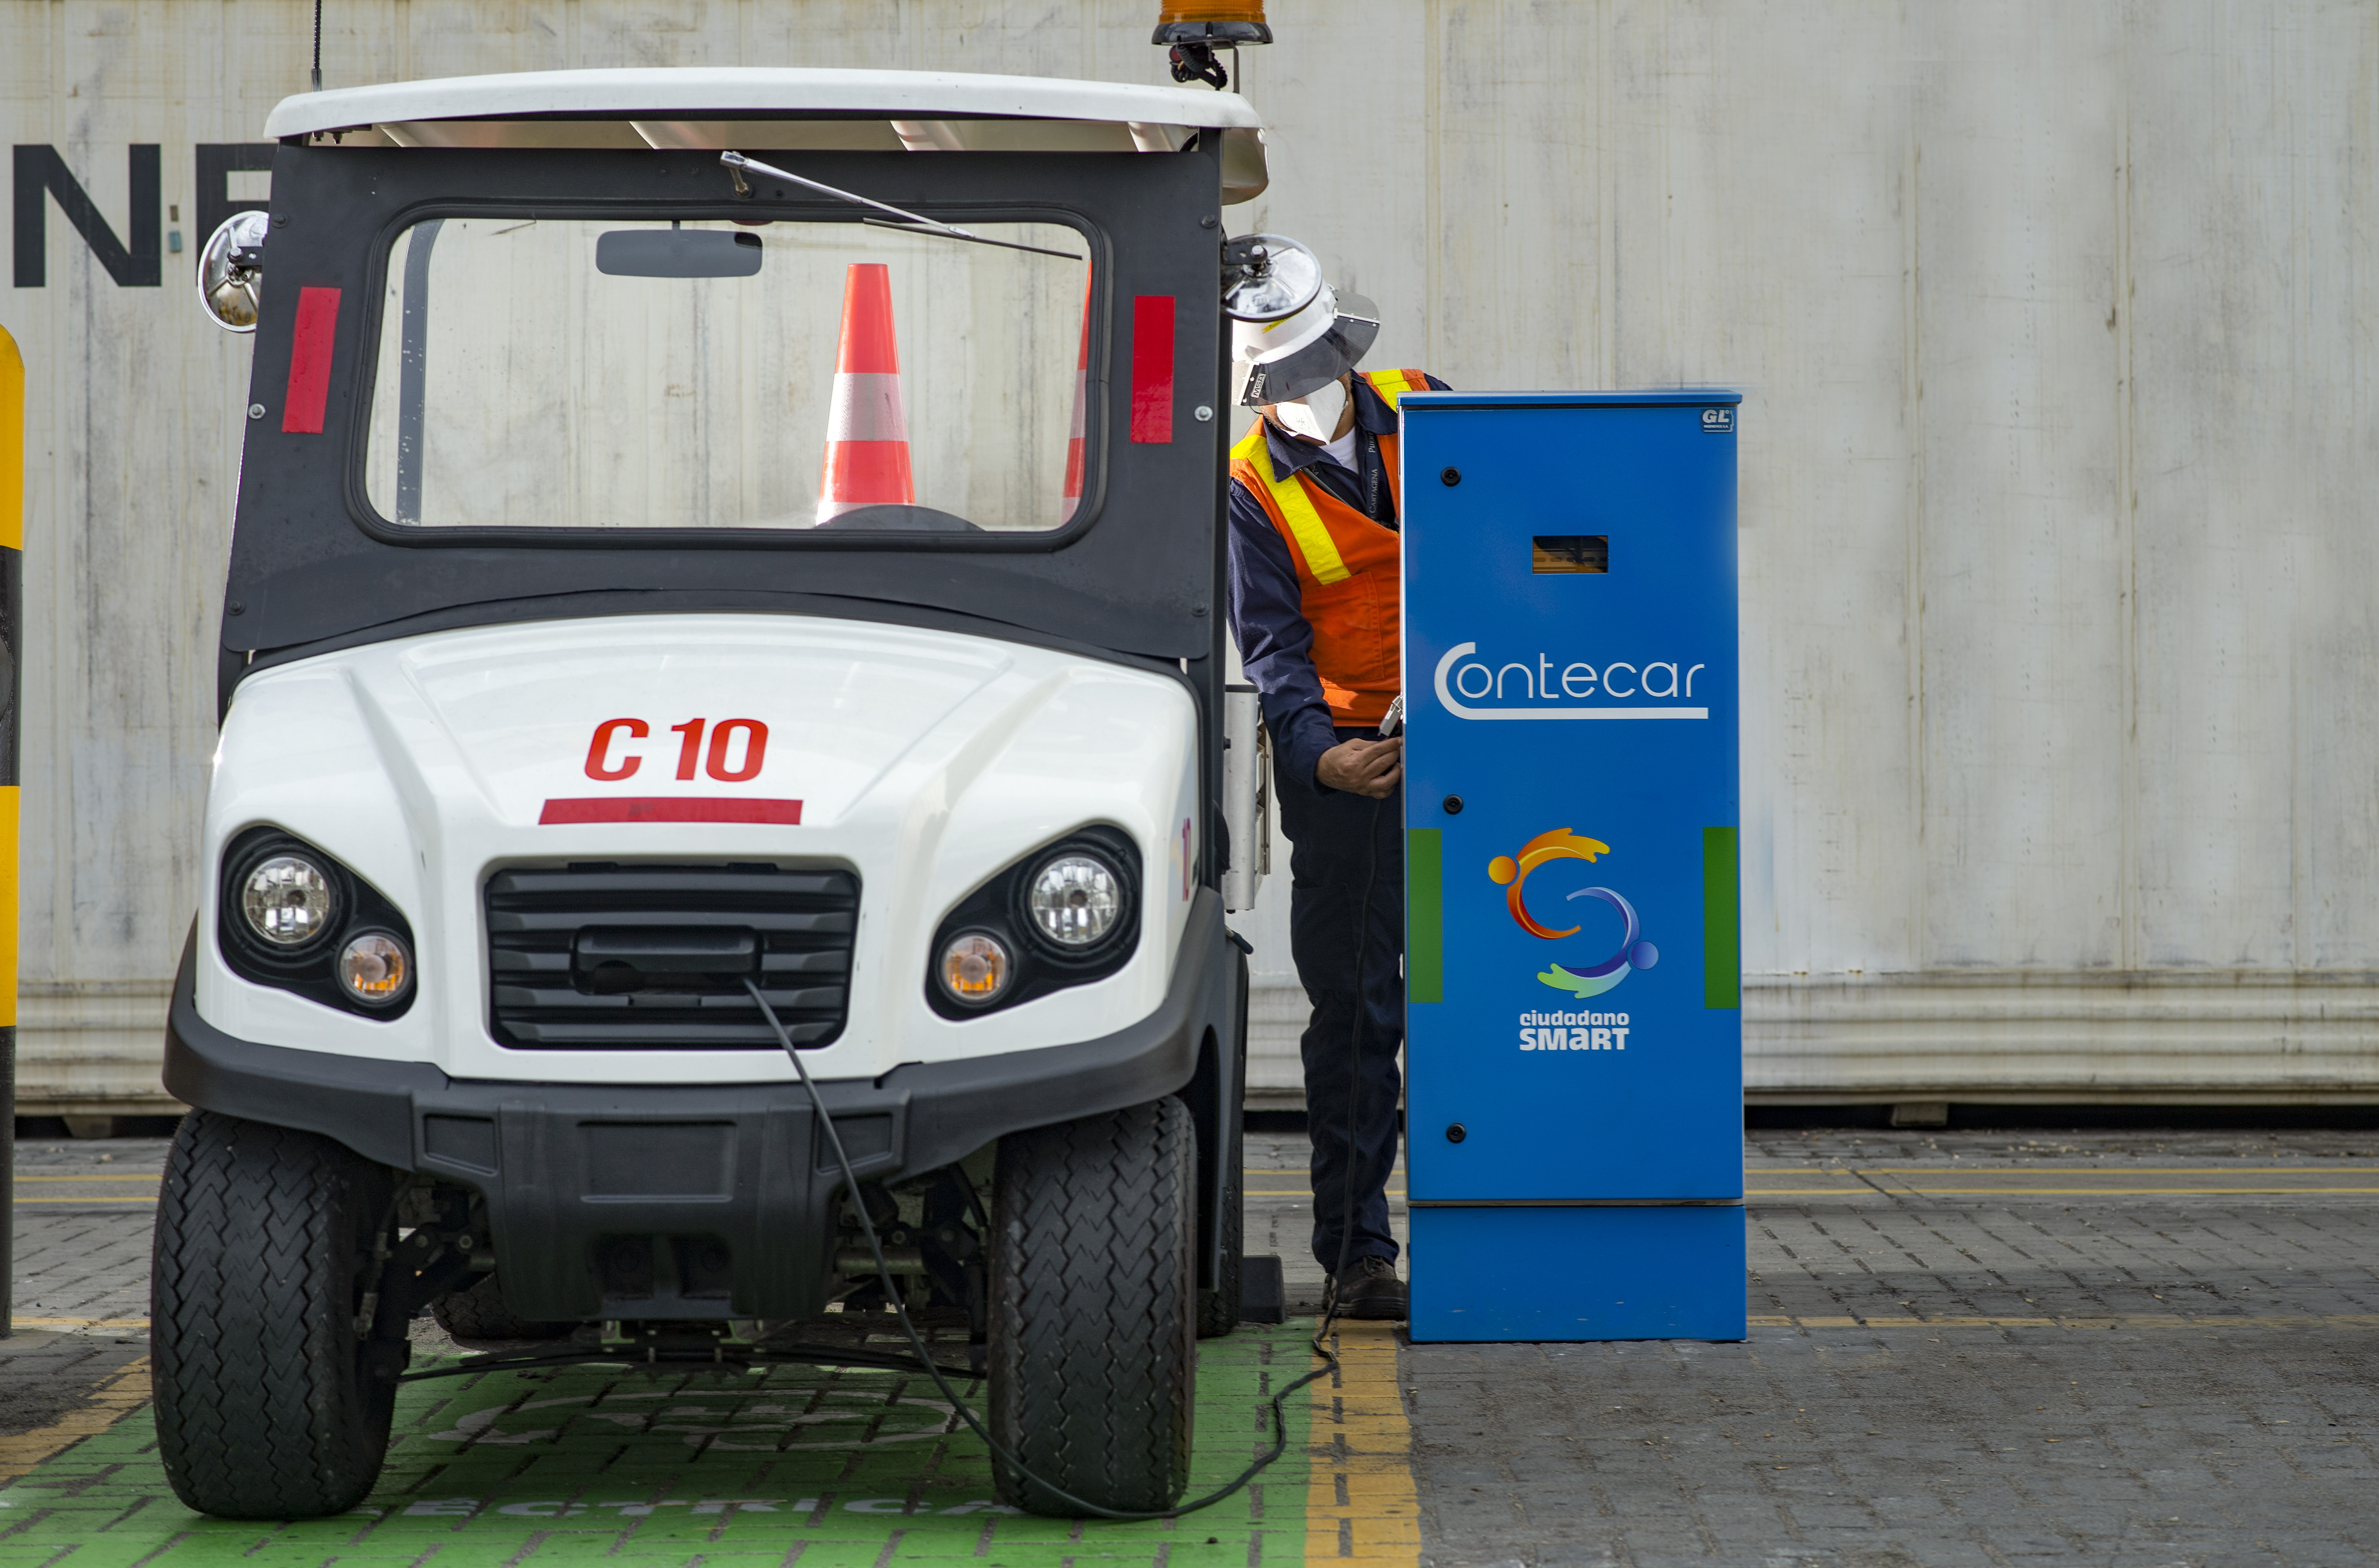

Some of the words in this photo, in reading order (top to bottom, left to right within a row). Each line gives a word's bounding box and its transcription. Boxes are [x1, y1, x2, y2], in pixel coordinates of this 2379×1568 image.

[1253, 375, 1265, 396] MSA
[1434, 642, 1709, 720] Contecar
[584, 718, 649, 781] C
[671, 718, 769, 782] 10
[1519, 1010, 1630, 1026] ciudadano
